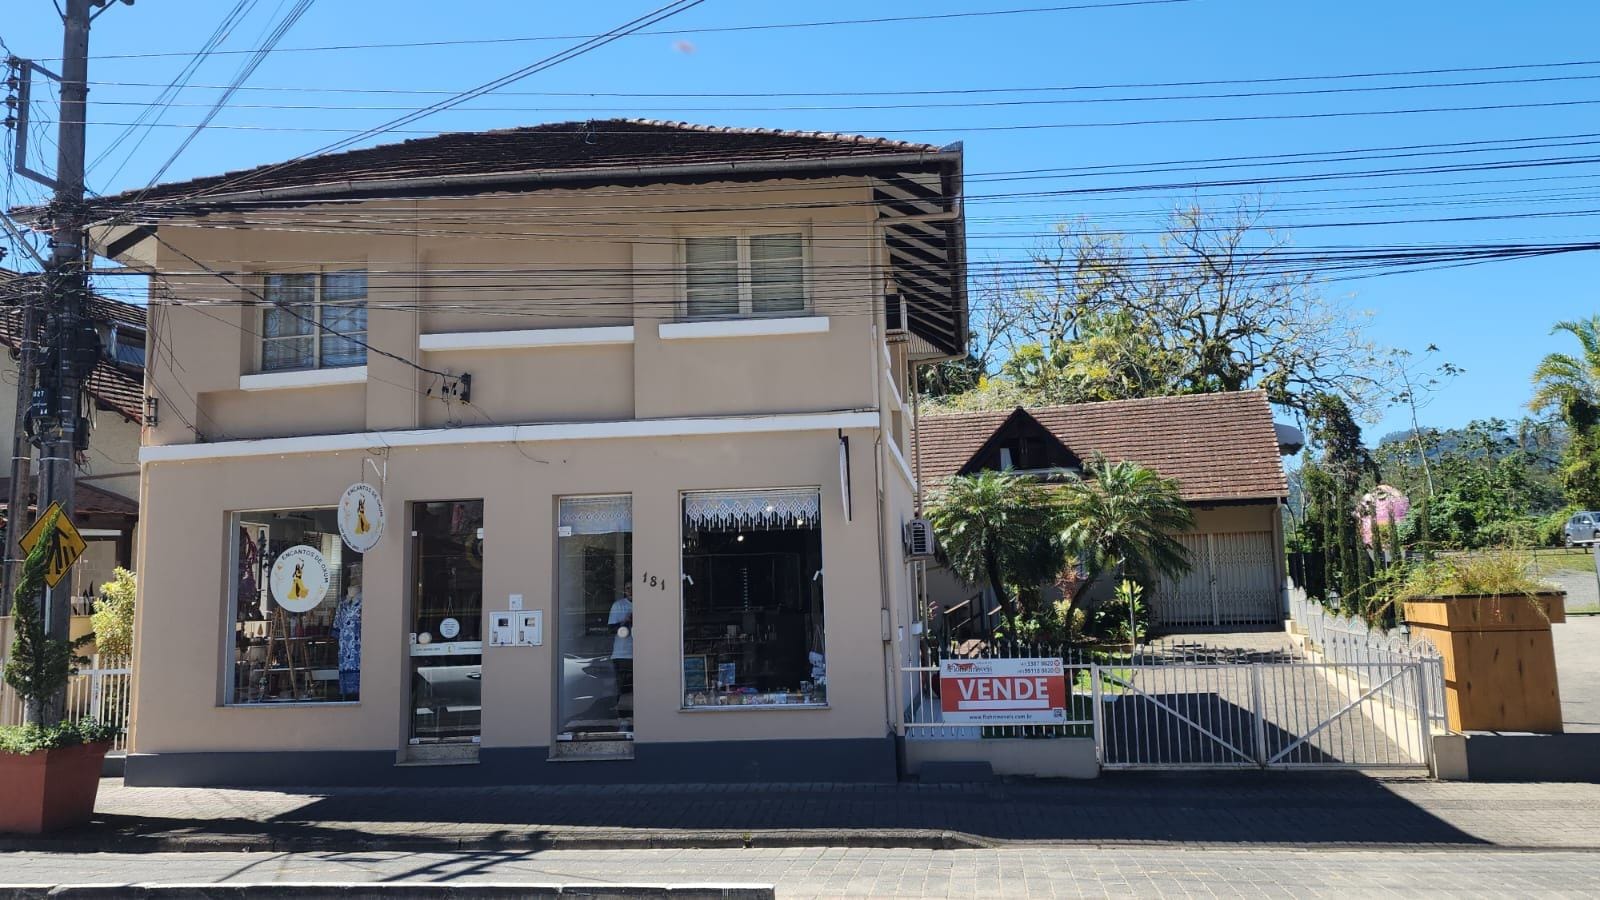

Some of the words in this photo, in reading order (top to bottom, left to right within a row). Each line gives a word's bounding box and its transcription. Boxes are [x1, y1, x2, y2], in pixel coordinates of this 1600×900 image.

[347, 485, 371, 497] ENCANTOS
[281, 549, 316, 561] ENCANTOS
[314, 555, 323, 565] DE
[643, 571, 665, 591] 181
[957, 678, 1049, 701] VENDE
